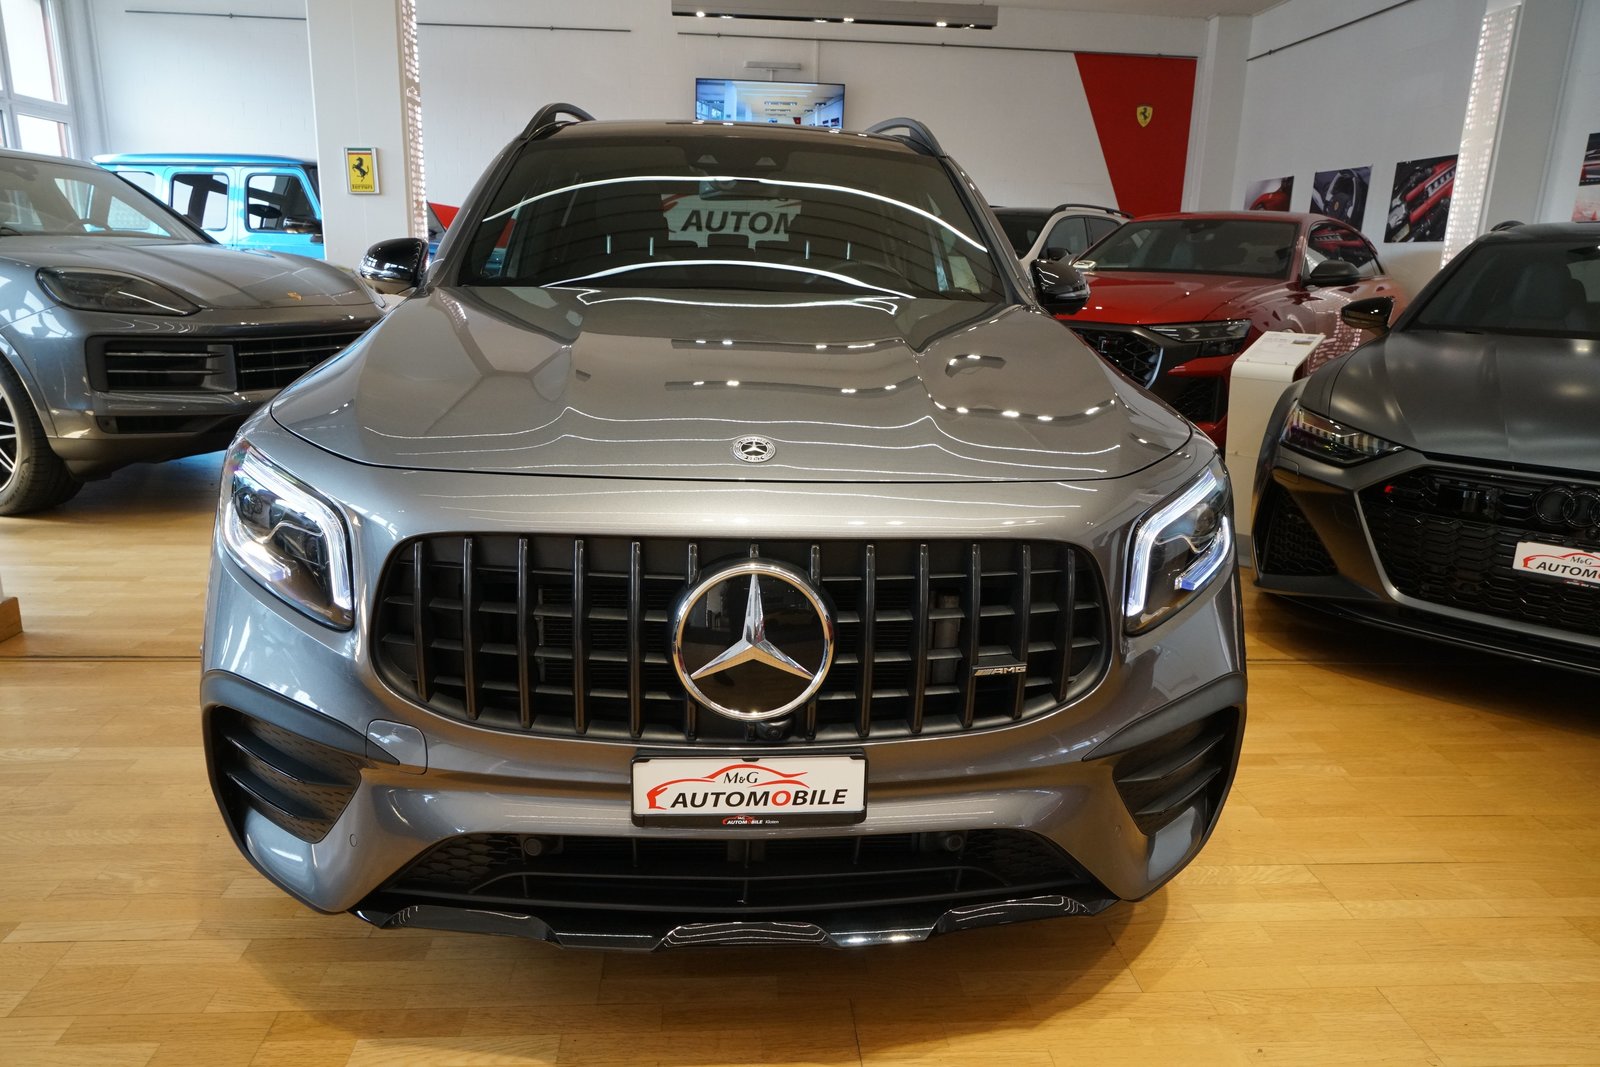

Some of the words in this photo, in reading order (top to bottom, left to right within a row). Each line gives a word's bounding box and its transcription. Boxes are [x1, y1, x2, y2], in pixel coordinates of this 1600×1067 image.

[1536, 561, 1600, 579] AUTOM
[723, 771, 760, 784] M&G
[670, 788, 849, 809] AUTOMOBILE
